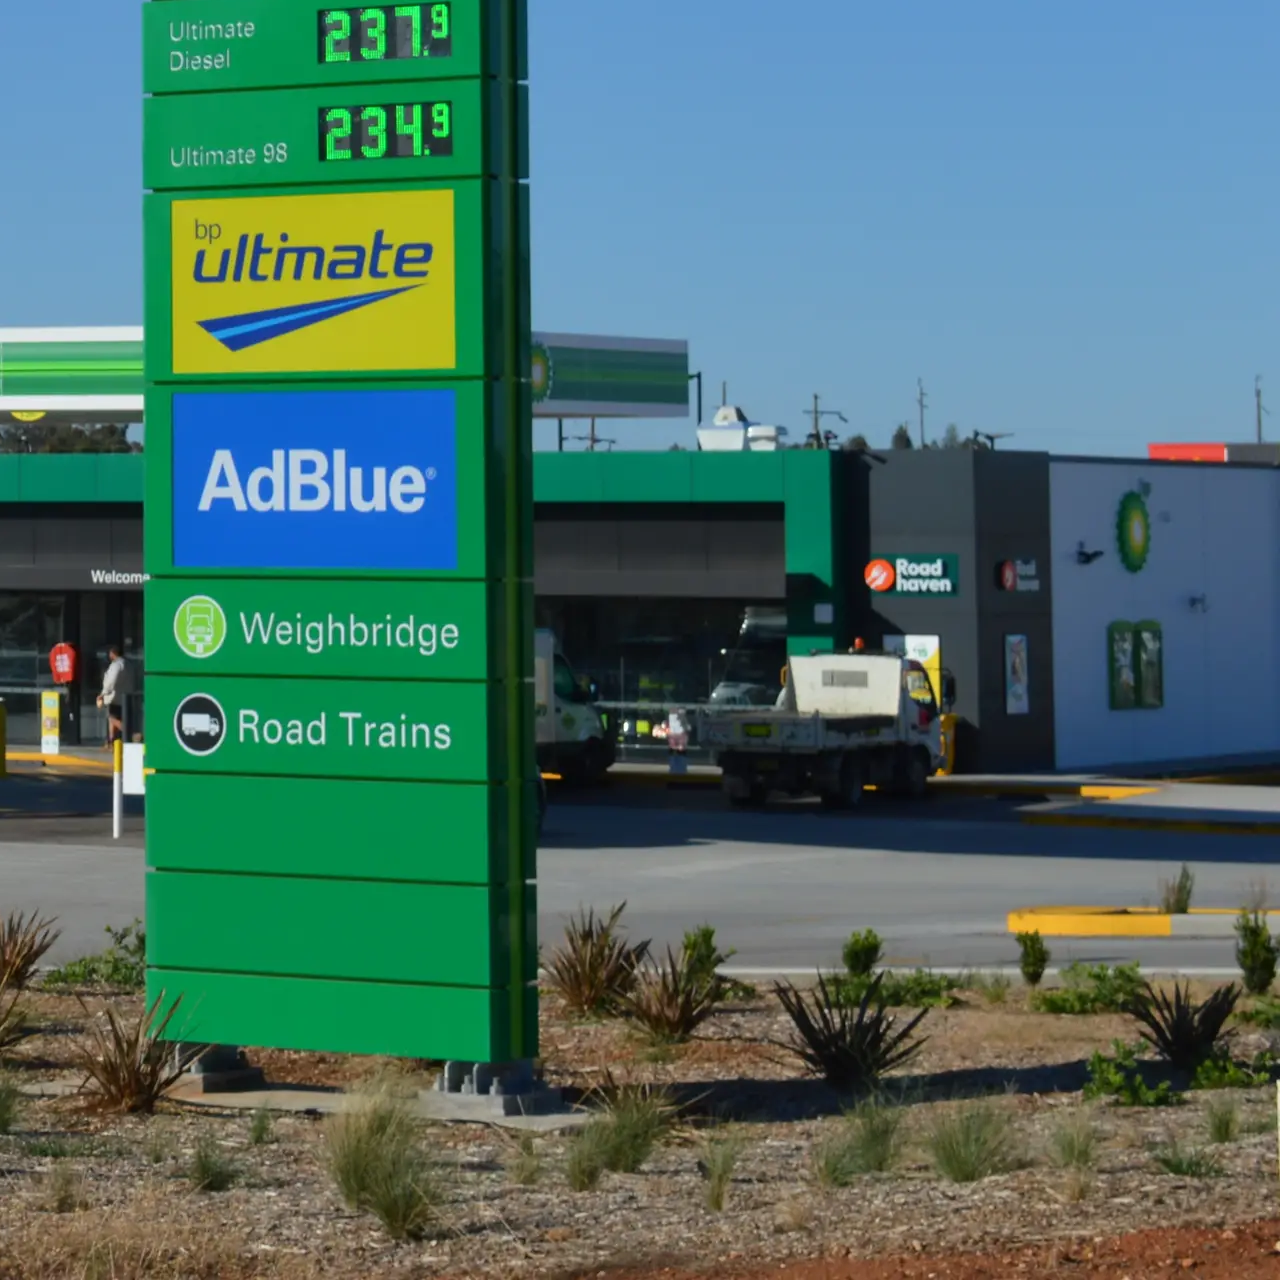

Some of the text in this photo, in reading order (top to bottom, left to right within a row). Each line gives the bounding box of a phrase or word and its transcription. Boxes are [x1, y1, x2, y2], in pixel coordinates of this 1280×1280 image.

[169, 20, 255, 42] Ultimate
[169, 48, 230, 72] Diesel
[170, 142, 288, 168] Ultimate 98
[194, 218, 222, 244] bp
[193, 229, 434, 283] ultimate
[90, 569, 151, 584] Welcome
[895, 558, 943, 576] Road
[895, 578, 952, 592] haven
[239, 611, 459, 656] Weighbridge
[239, 709, 452, 750] Road Trains
